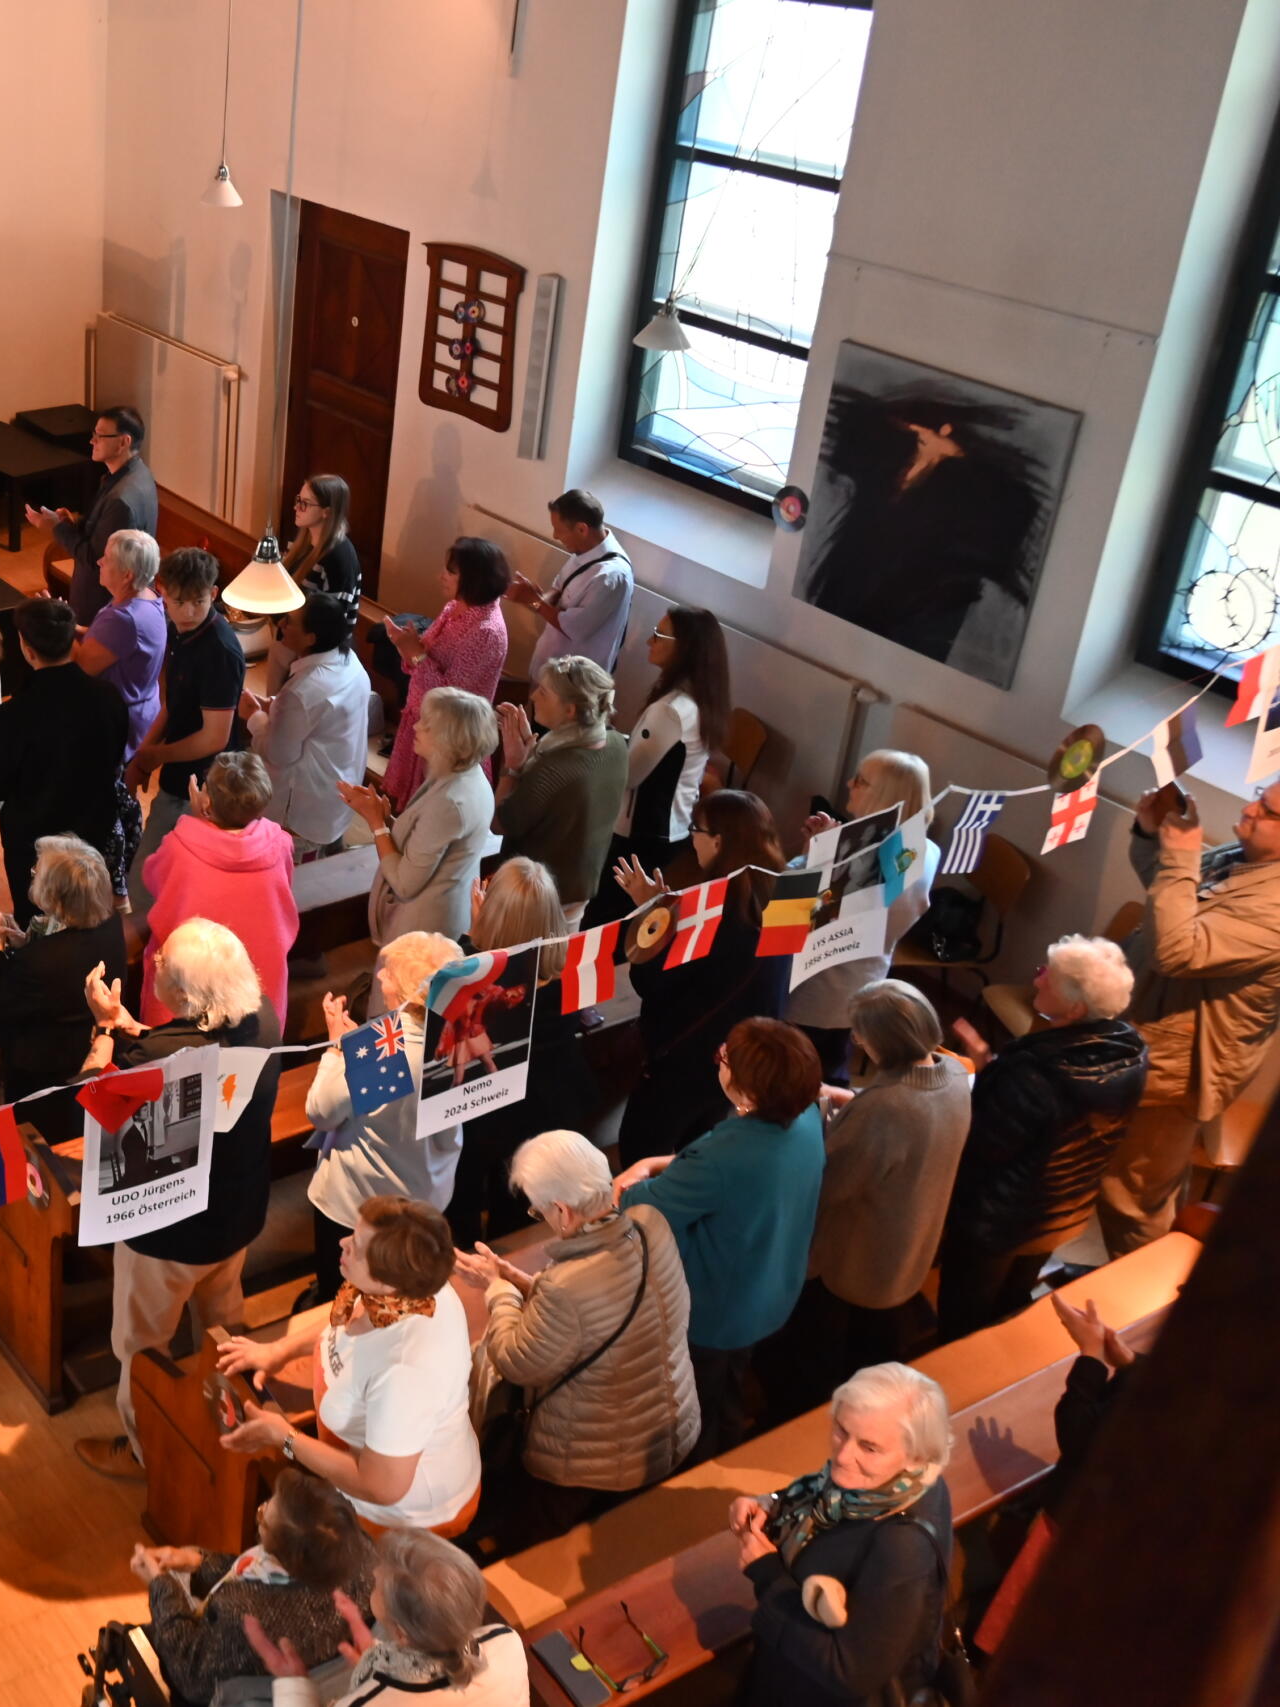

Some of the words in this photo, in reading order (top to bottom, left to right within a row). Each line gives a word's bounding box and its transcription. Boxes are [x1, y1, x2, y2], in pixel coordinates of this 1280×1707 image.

[444, 1103, 468, 1119] 2024
[470, 1087, 509, 1109] Schweiz
[463, 1079, 492, 1096] Nemo
[106, 1209, 135, 1224] 1966
[138, 1187, 196, 1215] Österreich
[111, 1191, 140, 1206] UDO
[142, 1176, 185, 1198] Jürgens
